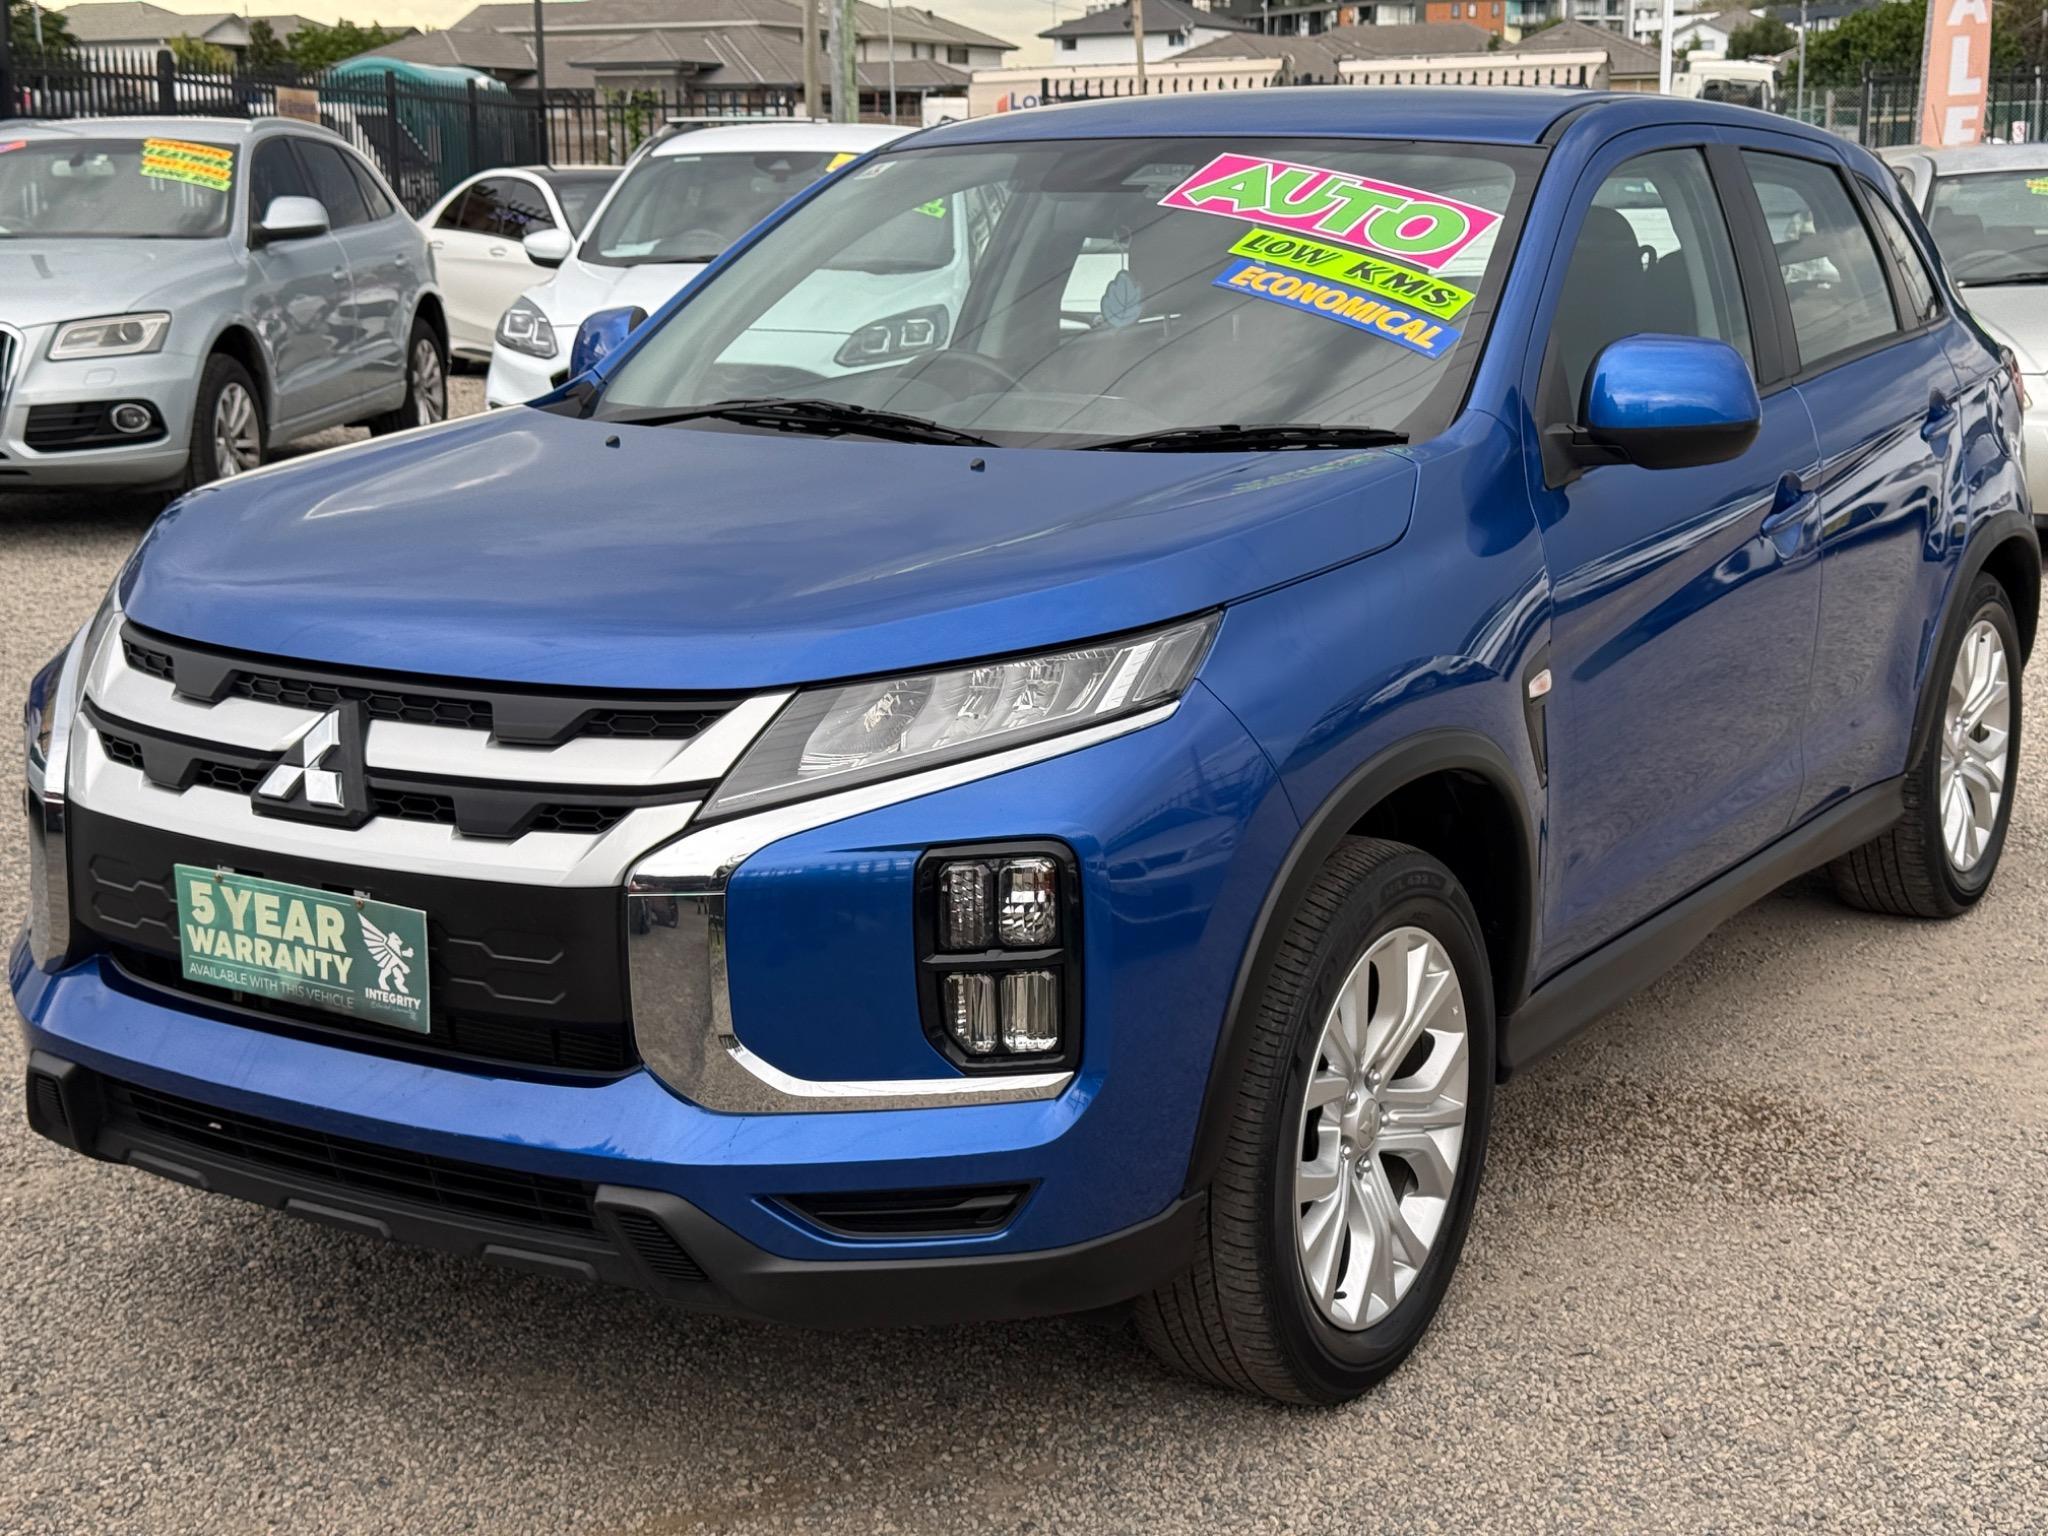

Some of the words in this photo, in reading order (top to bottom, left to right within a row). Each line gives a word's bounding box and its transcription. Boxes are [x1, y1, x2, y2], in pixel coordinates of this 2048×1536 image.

[1183, 163, 1470, 254] AUTO
[1241, 233, 1343, 267] LOW
[1344, 260, 1461, 308] KMS
[1228, 266, 1443, 349] ECONOMICAL
[190, 880, 216, 925] 5
[219, 886, 347, 953] YEAR
[186, 924, 353, 985] WARRANTY
[189, 962, 247, 985] AVAILABLE
[249, 974, 278, 992] WITH
[280, 980, 304, 999] THIS
[305, 986, 354, 1010] VEHICLE
[365, 987, 421, 1010] INTEGRITY
